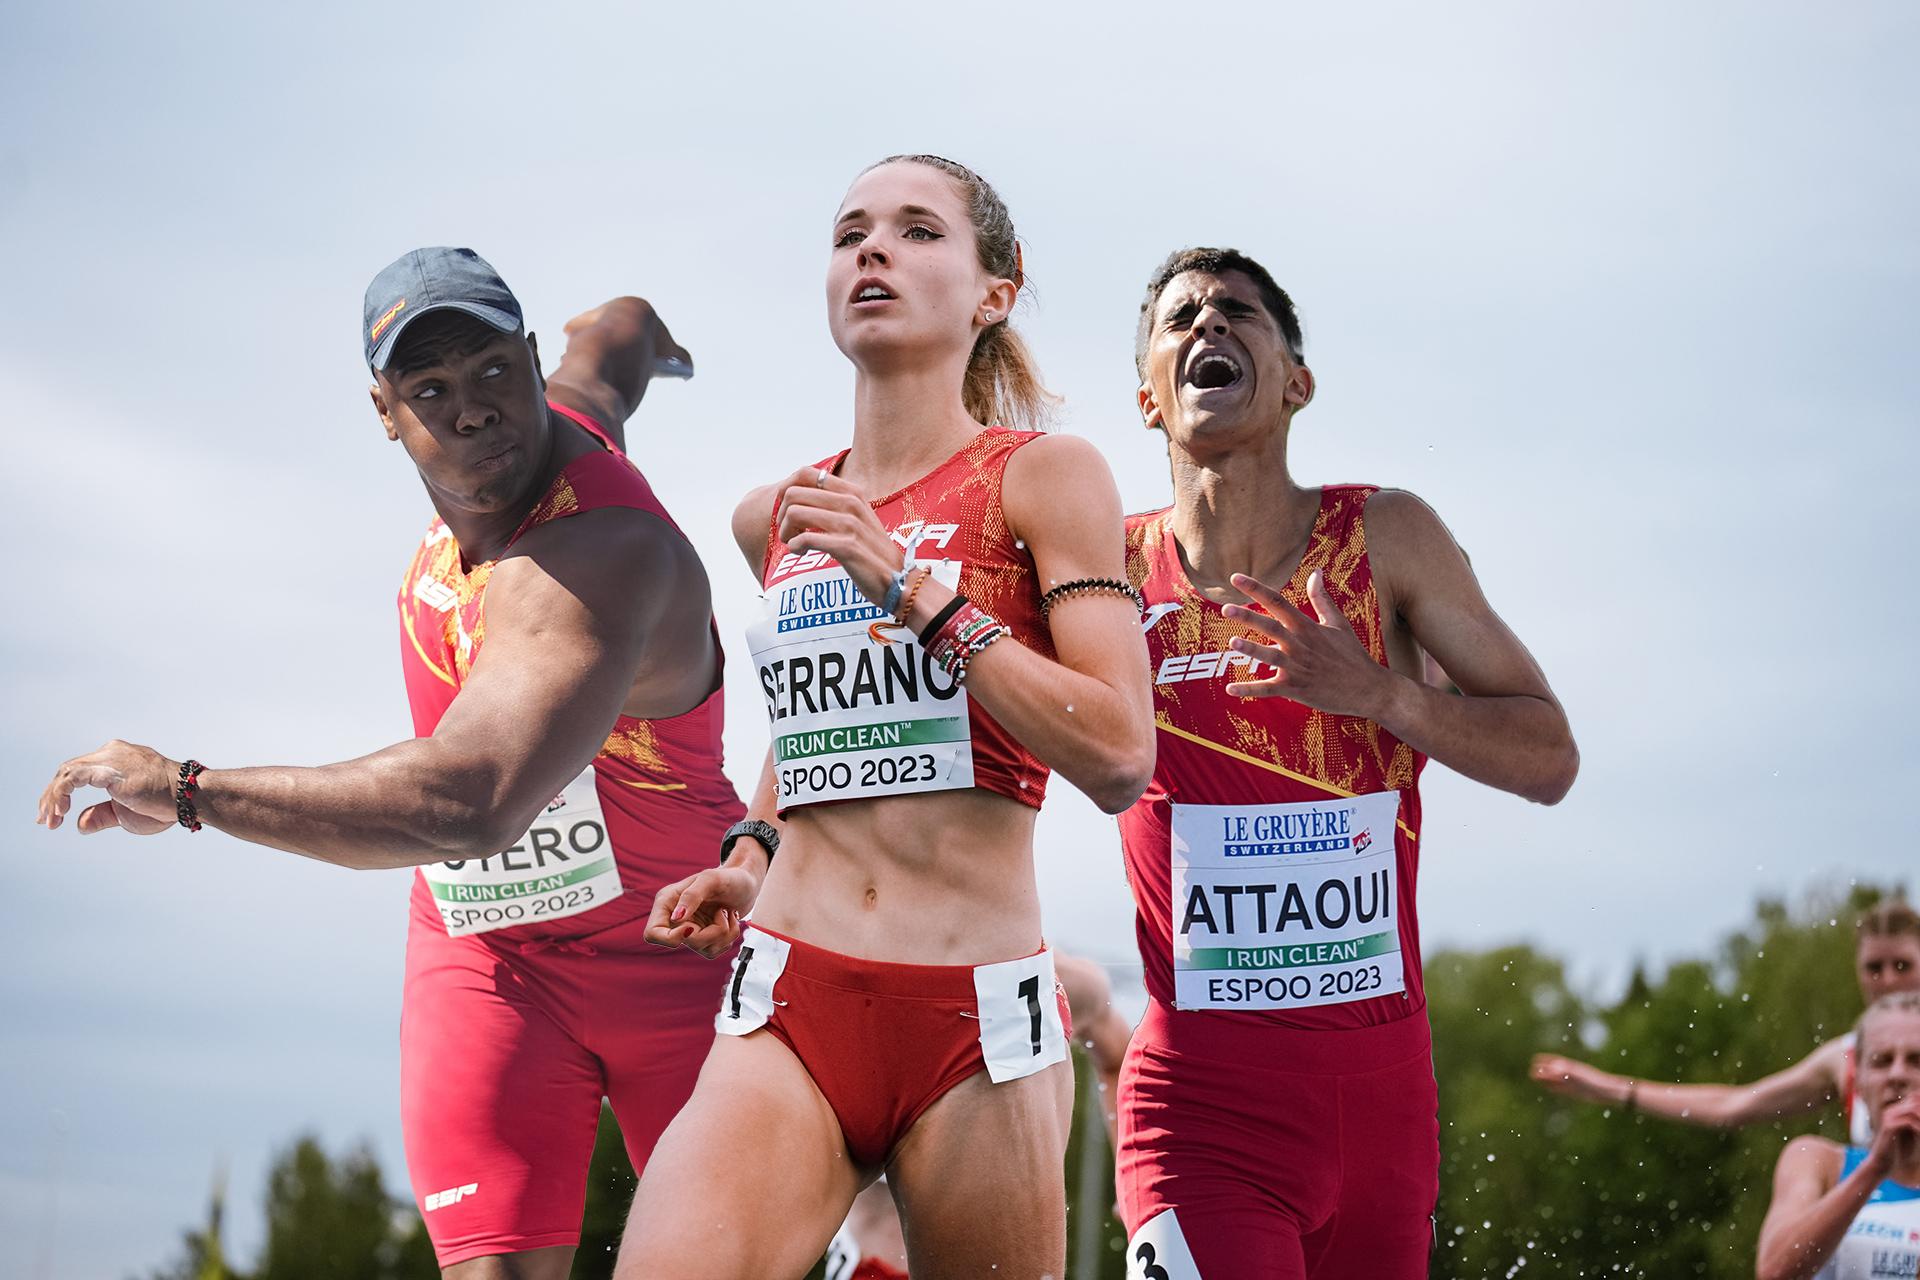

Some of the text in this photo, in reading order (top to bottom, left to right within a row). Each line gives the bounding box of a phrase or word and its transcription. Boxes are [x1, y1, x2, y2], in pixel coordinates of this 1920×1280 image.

[779, 587, 797, 616] LE
[781, 606, 883, 631] SWITZERLAND
[760, 642, 960, 724] SERRANO
[780, 739, 785, 758] I
[787, 733, 825, 757] RUN
[860, 753, 937, 787] 2023
[1223, 817, 1248, 841] LE
[443, 820, 605, 872] ERO
[1229, 840, 1346, 856] SWITZERLAND
[456, 885, 496, 900] RUN
[531, 886, 595, 916] 2023
[1180, 869, 1390, 934] ATTAOUI
[1227, 950, 1232, 967] I
[1238, 948, 1283, 967] RUN
[727, 946, 755, 1020] 1
[1209, 965, 1382, 1002] ESPOO 2023
[1018, 974, 1040, 1058] 1
